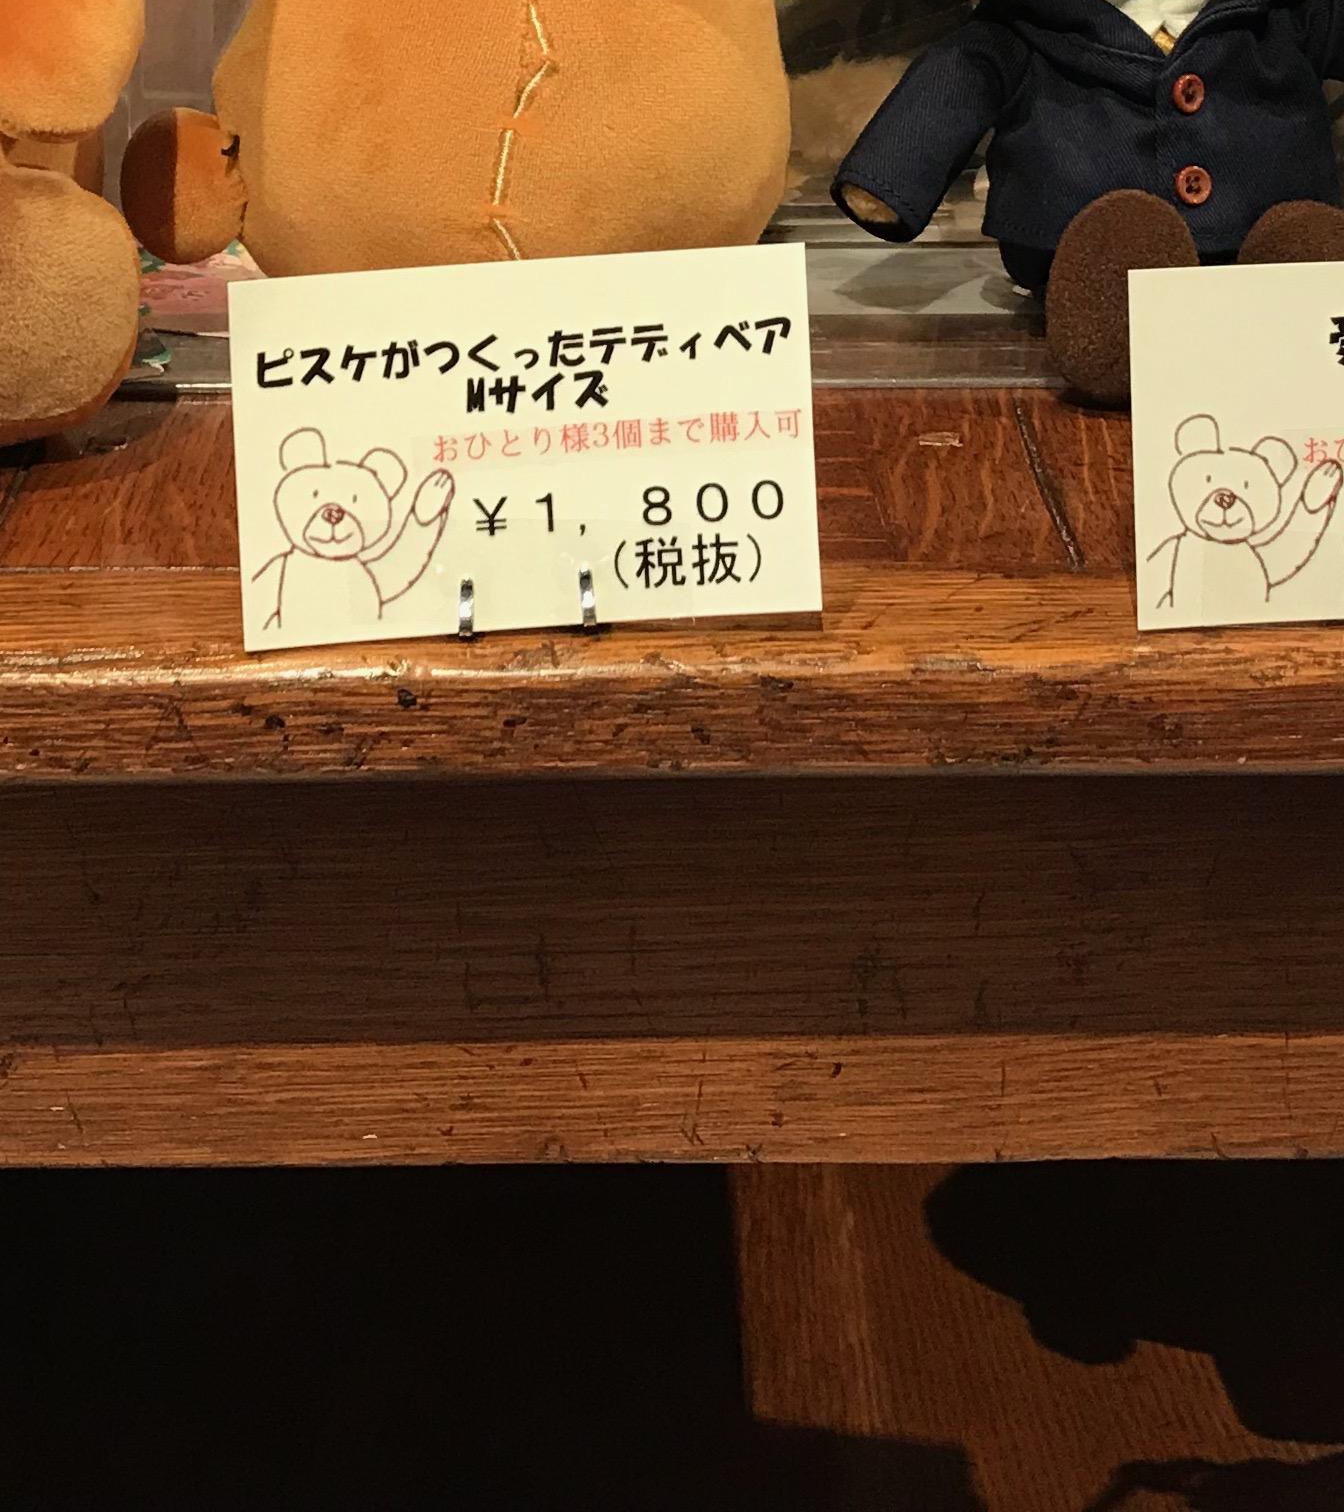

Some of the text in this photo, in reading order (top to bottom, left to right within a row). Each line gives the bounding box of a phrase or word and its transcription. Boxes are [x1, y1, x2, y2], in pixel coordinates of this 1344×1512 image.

[256, 316, 793, 388] ピスケがつくったテディベア
[466, 370, 610, 415] Mサイズ
[432, 408, 803, 464] おひとり様3個まで購入可
[613, 533, 764, 590] (税抜)
